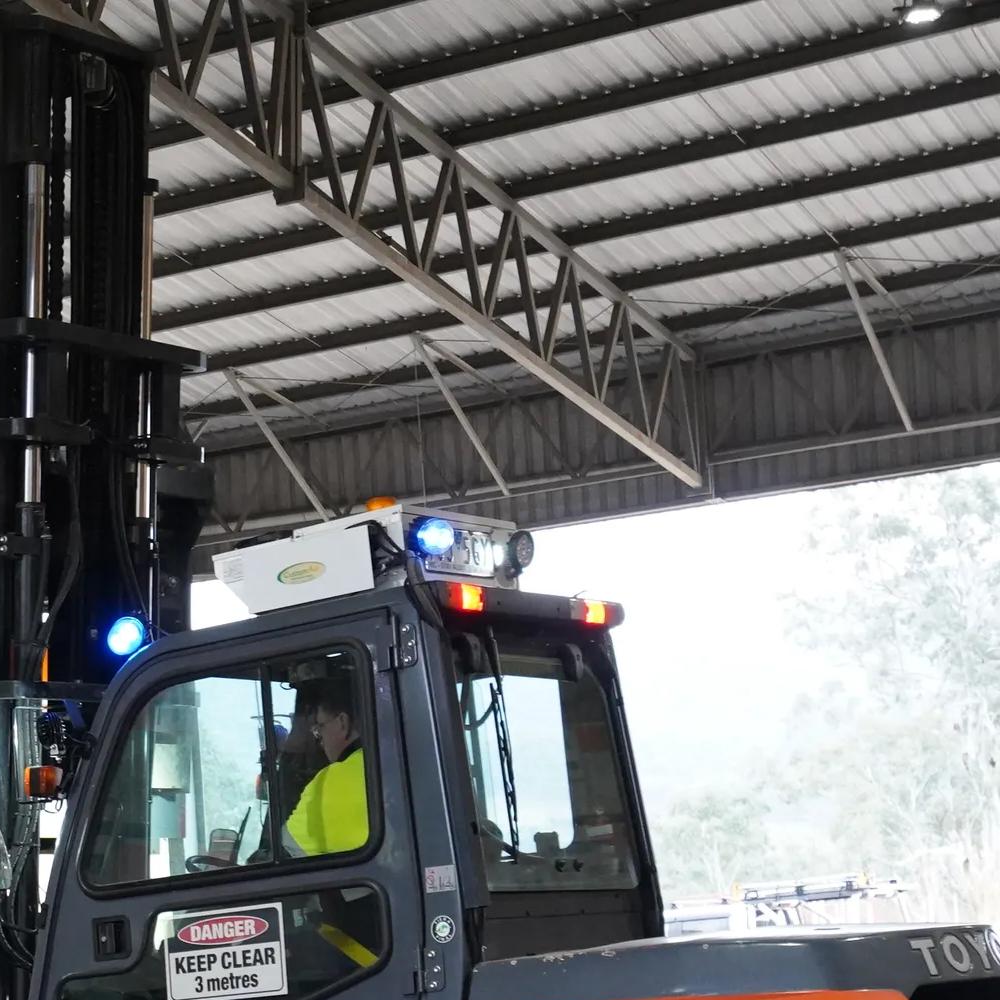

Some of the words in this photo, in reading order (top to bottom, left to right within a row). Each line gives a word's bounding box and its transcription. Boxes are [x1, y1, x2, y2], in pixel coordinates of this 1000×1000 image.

[190, 919, 256, 942] DANGER
[175, 953, 218, 975] KEEP
[221, 947, 276, 970] CLEAR
[194, 976, 204, 993] 3
[207, 972, 259, 992] metres
